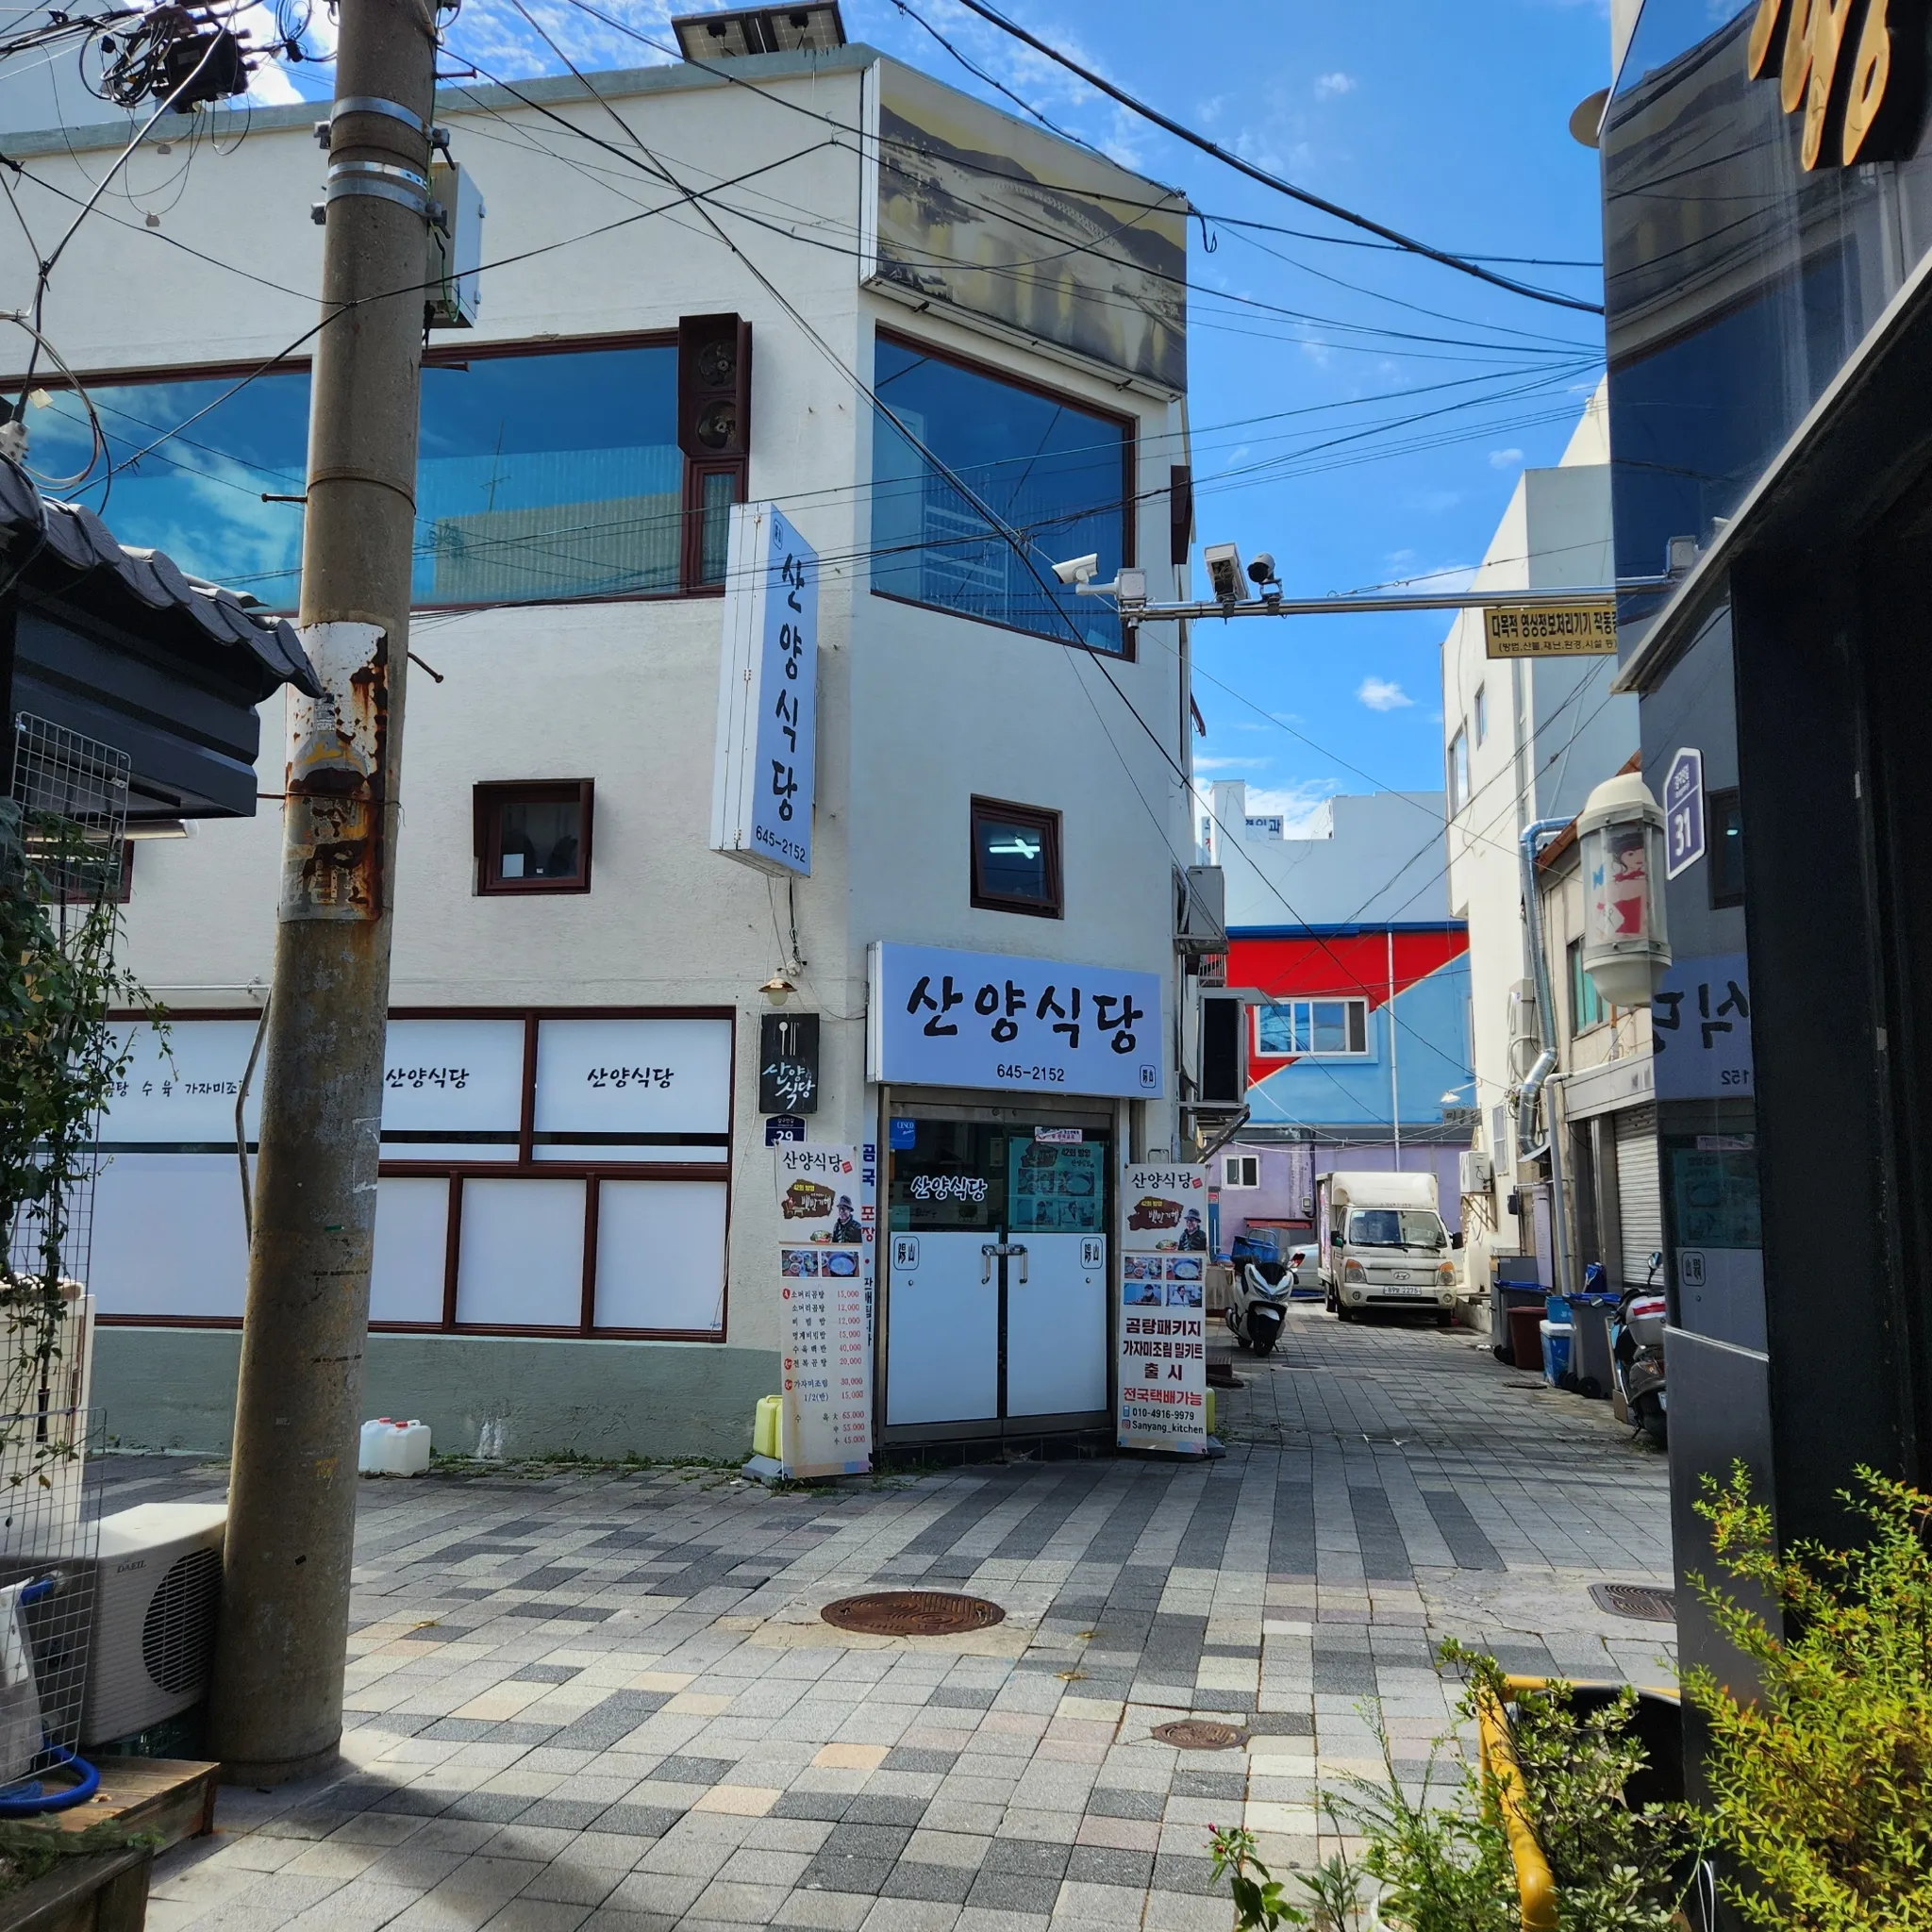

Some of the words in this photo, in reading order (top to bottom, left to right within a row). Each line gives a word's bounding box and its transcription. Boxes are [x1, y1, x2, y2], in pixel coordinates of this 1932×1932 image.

[1491, 614, 1519, 638] 다목적
[1521, 612, 1592, 638] 영상정보처리기기
[772, 553, 806, 823] 산양식당
[1674, 807, 1691, 857] 31
[756, 824, 807, 863] 645-2152
[907, 975, 1143, 1055] 산양식당
[385, 1067, 470, 1089] 산양식당
[587, 1066, 675, 1089] 산양식당
[762, 1061, 806, 1086] 산양
[996, 1064, 1065, 1082] 645-2152
[185, 1081, 250, 1096] 가자미조
[774, 1079, 816, 1110] 식당
[775, 1130, 794, 1142] 29
[783, 1150, 843, 1174] 산양식당
[910, 1175, 989, 1202] 산양식당
[1131, 1172, 1193, 1190] 산양식당
[861, 1206, 875, 1242] 포장
[1125, 1317, 1201, 1337] 곰탕패키지
[1123, 1340, 1173, 1358] 가자미조림
[1174, 1342, 1204, 1359] 밀키트
[839, 1357, 862, 1366] 20,000
[793, 1378, 828, 1389] 가자미조림
[841, 1377, 863, 1387] 30,000
[805, 1391, 829, 1403] 1/2(반)
[1123, 1387, 1203, 1407] 전국택배가능
[1132, 1407, 1194, 1421] 010-4916-9979
[1132, 1420, 1204, 1435] Sanyang_kitchen
